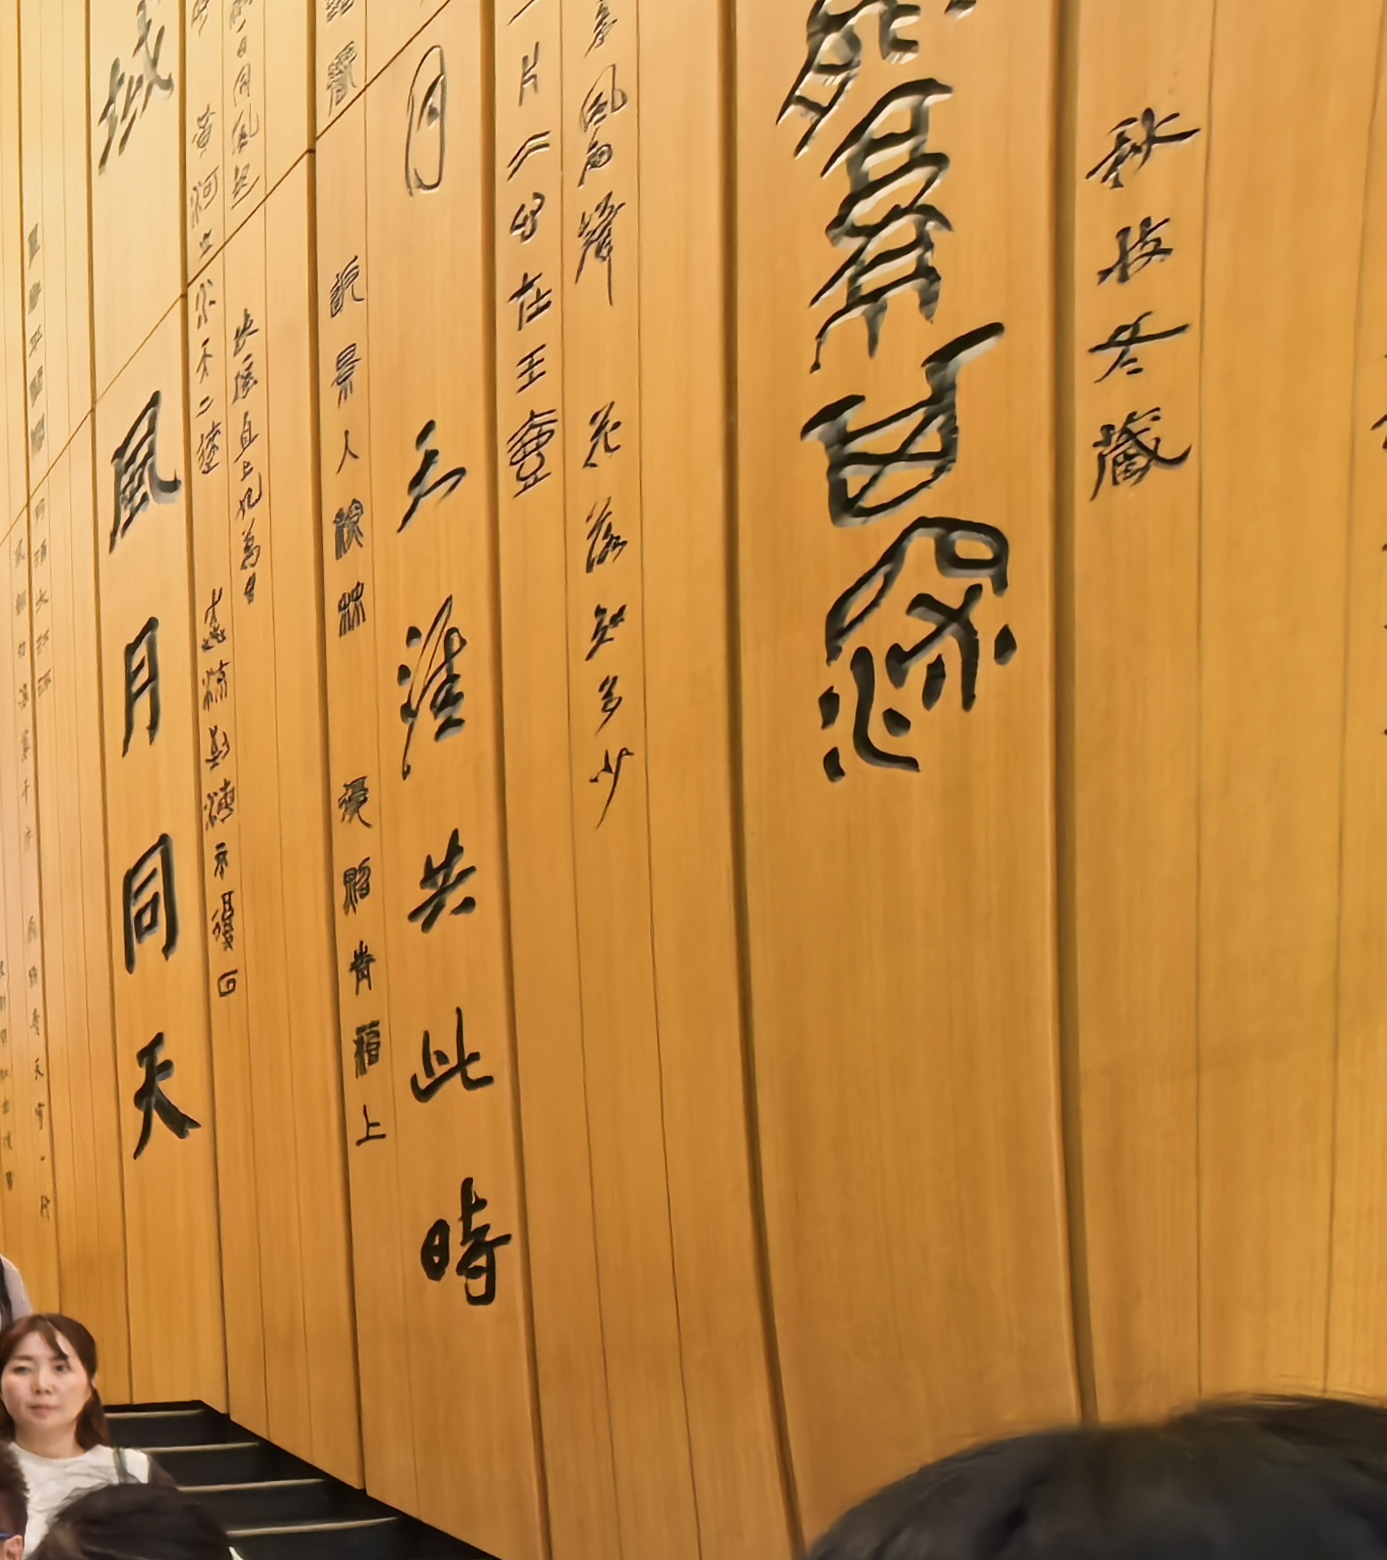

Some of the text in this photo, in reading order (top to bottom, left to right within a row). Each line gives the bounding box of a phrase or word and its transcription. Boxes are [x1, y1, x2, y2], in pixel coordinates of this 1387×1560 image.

[1085, 106, 1202, 502] 秋收冬藏
[108, 388, 203, 1162] 風月同天
